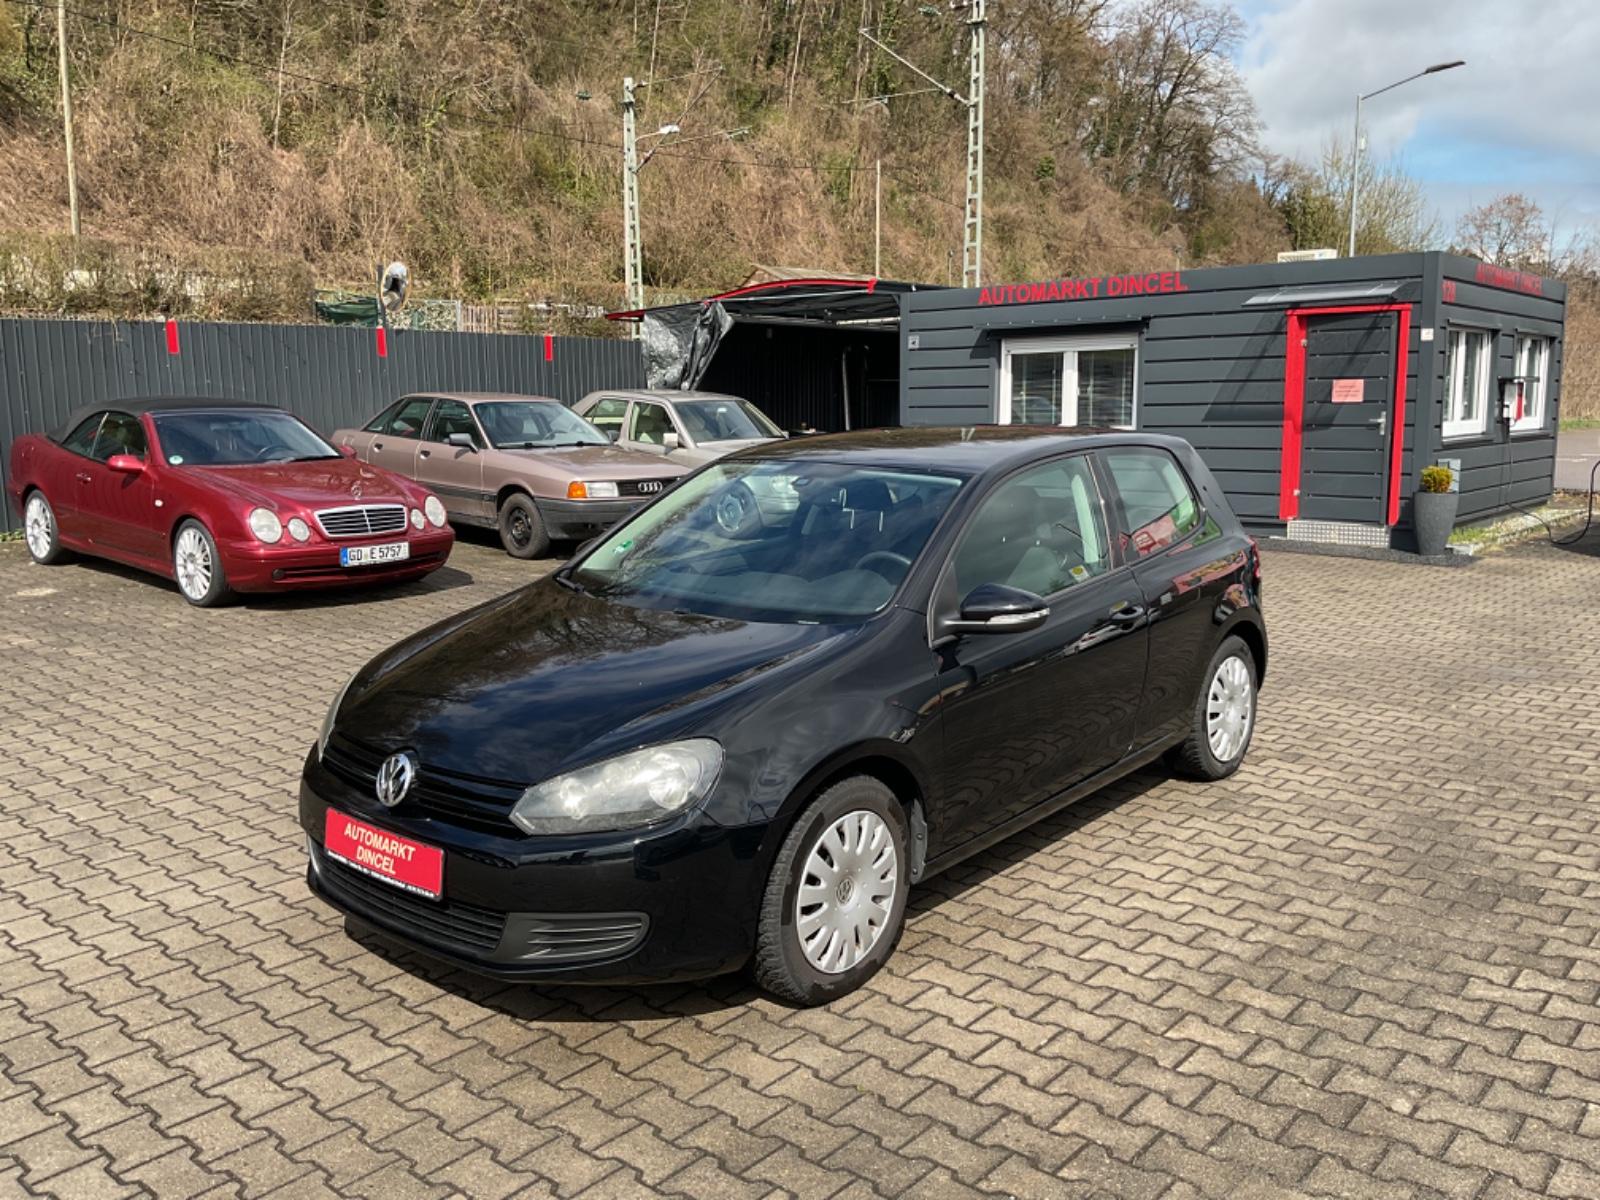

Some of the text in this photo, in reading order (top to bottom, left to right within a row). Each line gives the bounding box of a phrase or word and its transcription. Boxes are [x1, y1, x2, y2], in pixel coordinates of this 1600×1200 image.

[978, 271, 1189, 305] AUTOMARKT DINCEL
[349, 545, 402, 561] GD E 5757
[344, 822, 416, 861] AUTOMARKT
[356, 845, 396, 874] DINCEL
